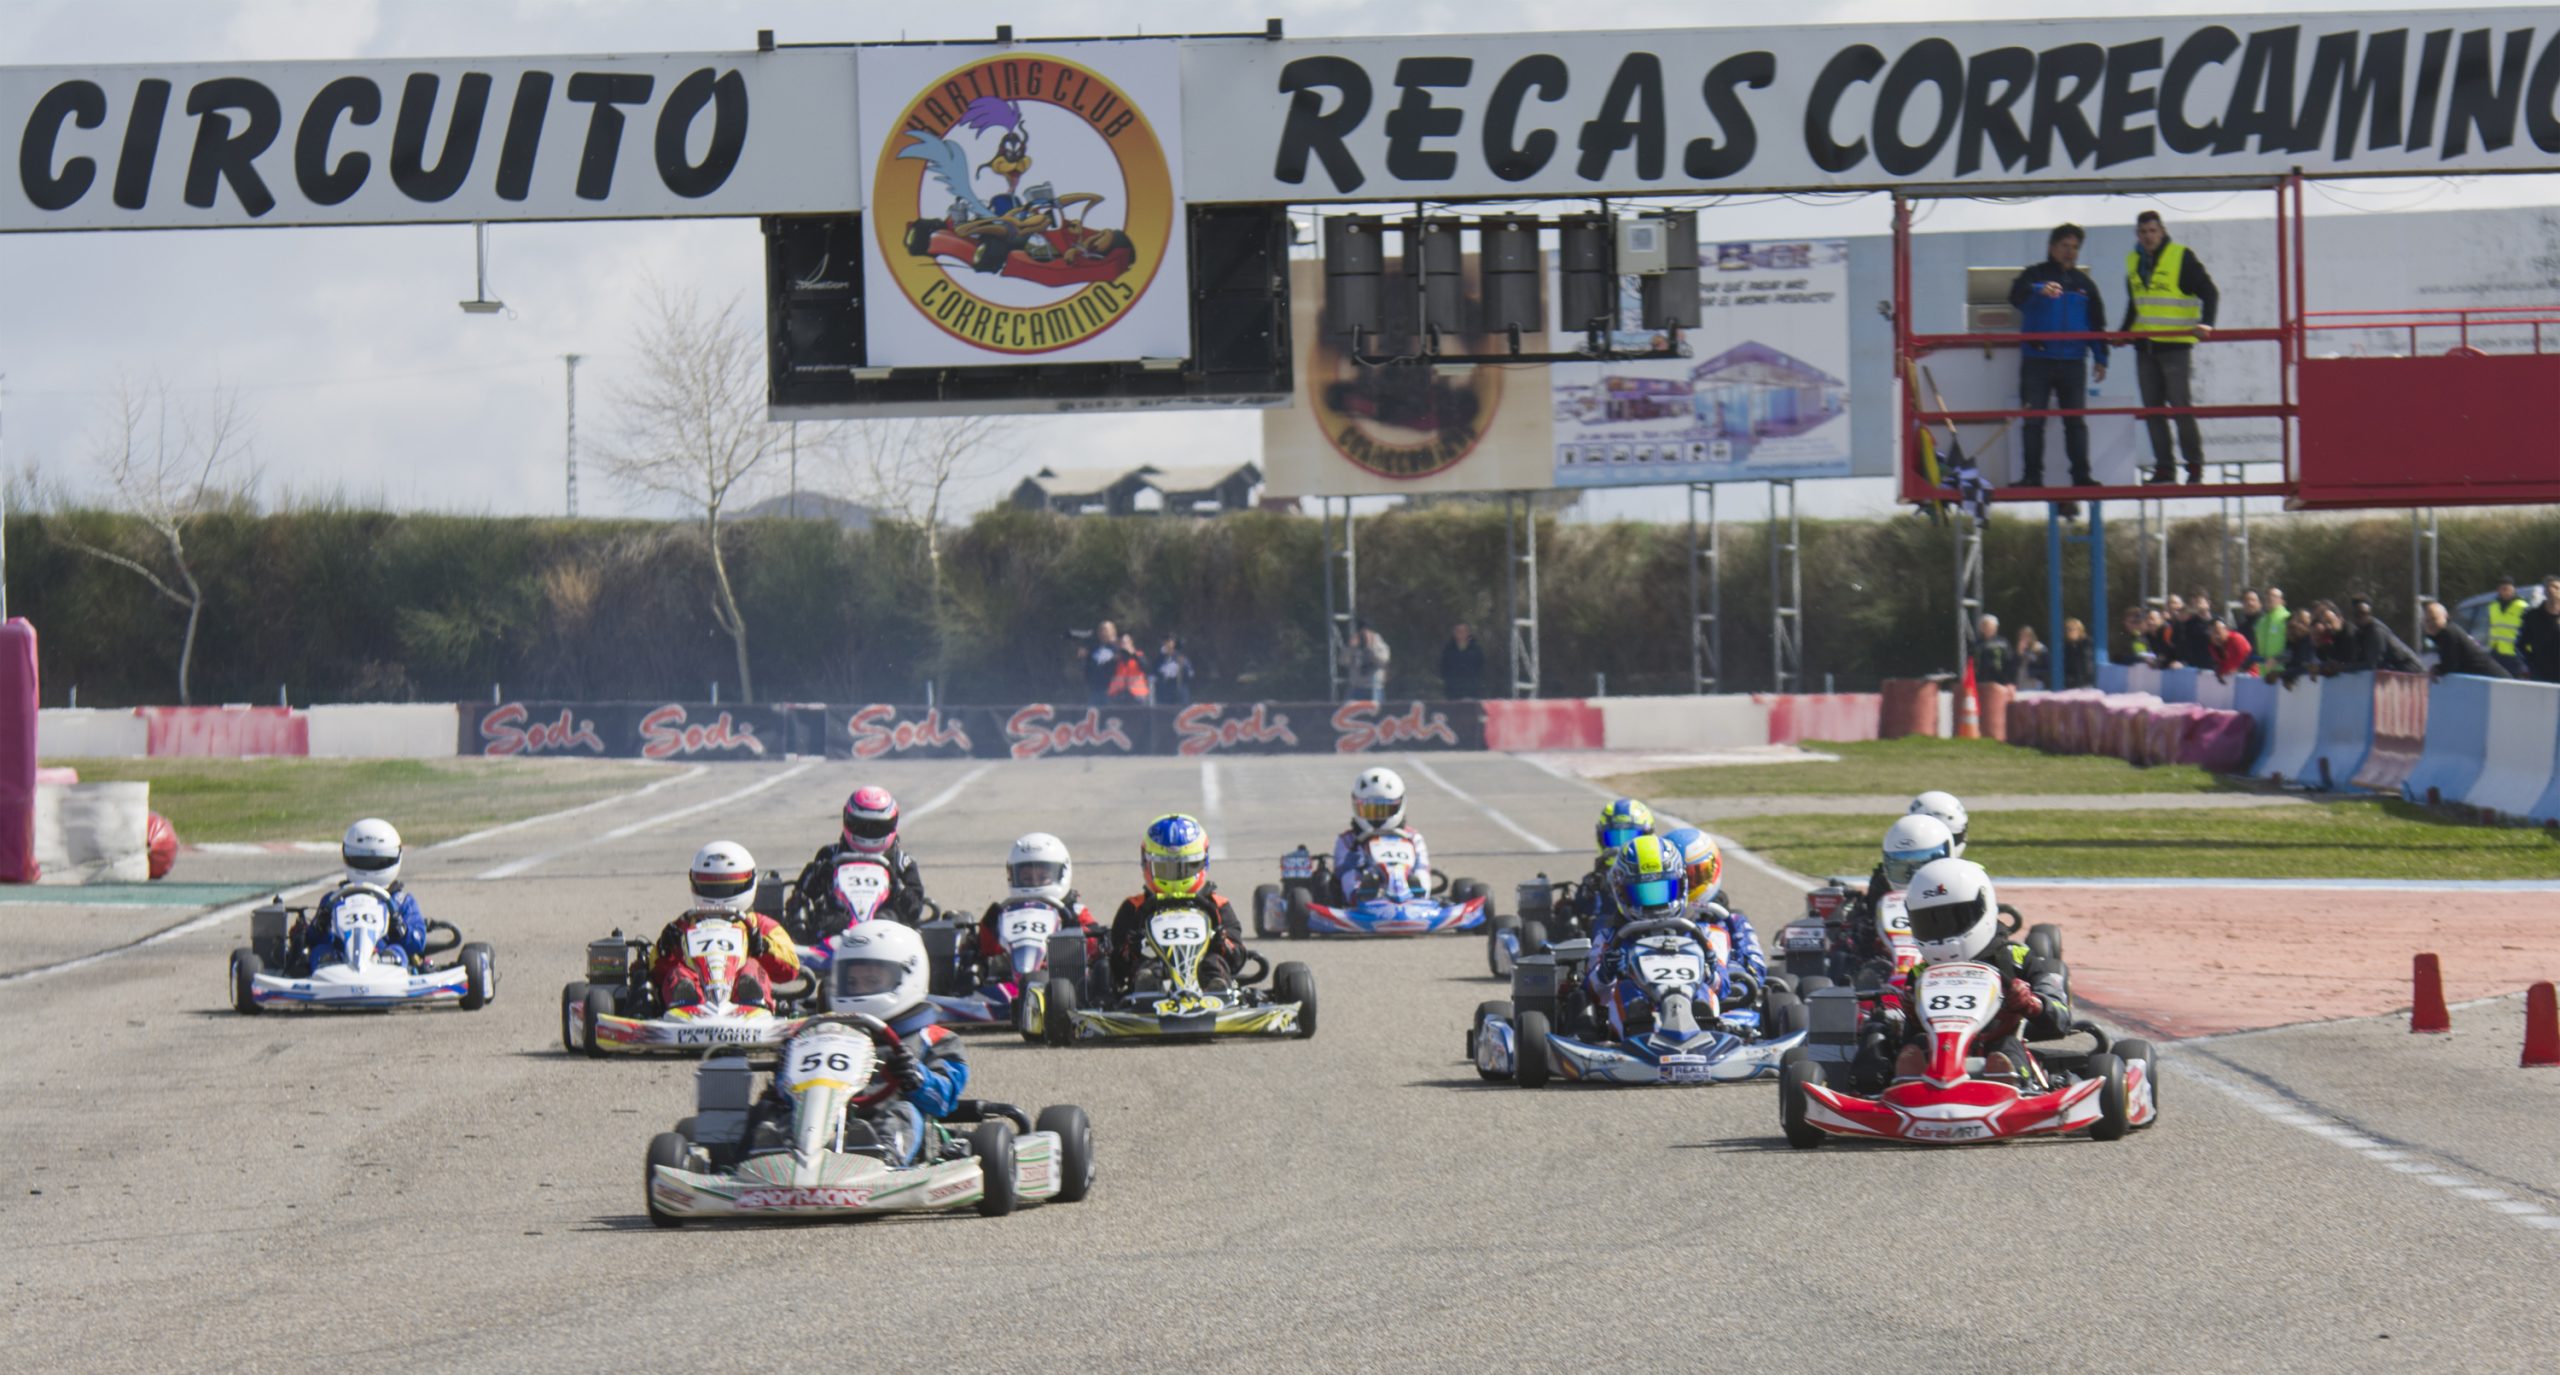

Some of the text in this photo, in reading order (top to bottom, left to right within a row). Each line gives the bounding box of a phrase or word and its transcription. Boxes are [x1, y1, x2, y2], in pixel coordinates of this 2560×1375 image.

[906, 61, 1134, 138] KARTING CLUB
[20, 67, 748, 217] CIRCUITO
[1275, 51, 1777, 193] RECAS
[920, 278, 1134, 348] CORRECAMINOS
[480, 704, 604, 756] Sodi
[639, 704, 767, 758] Sodi
[847, 704, 972, 759] Sodi
[1004, 703, 1133, 758] Sodi
[1173, 703, 1298, 756] Sodi
[1331, 700, 1457, 754] Sodi
[848, 876, 879, 887] 39
[345, 912, 377, 925] 36
[1012, 921, 1046, 934] 58
[1162, 927, 1200, 940] 85
[697, 938, 734, 952] 79
[1653, 968, 1695, 980] 29
[1929, 995, 1976, 1010] 83
[799, 1053, 849, 1073] 56
